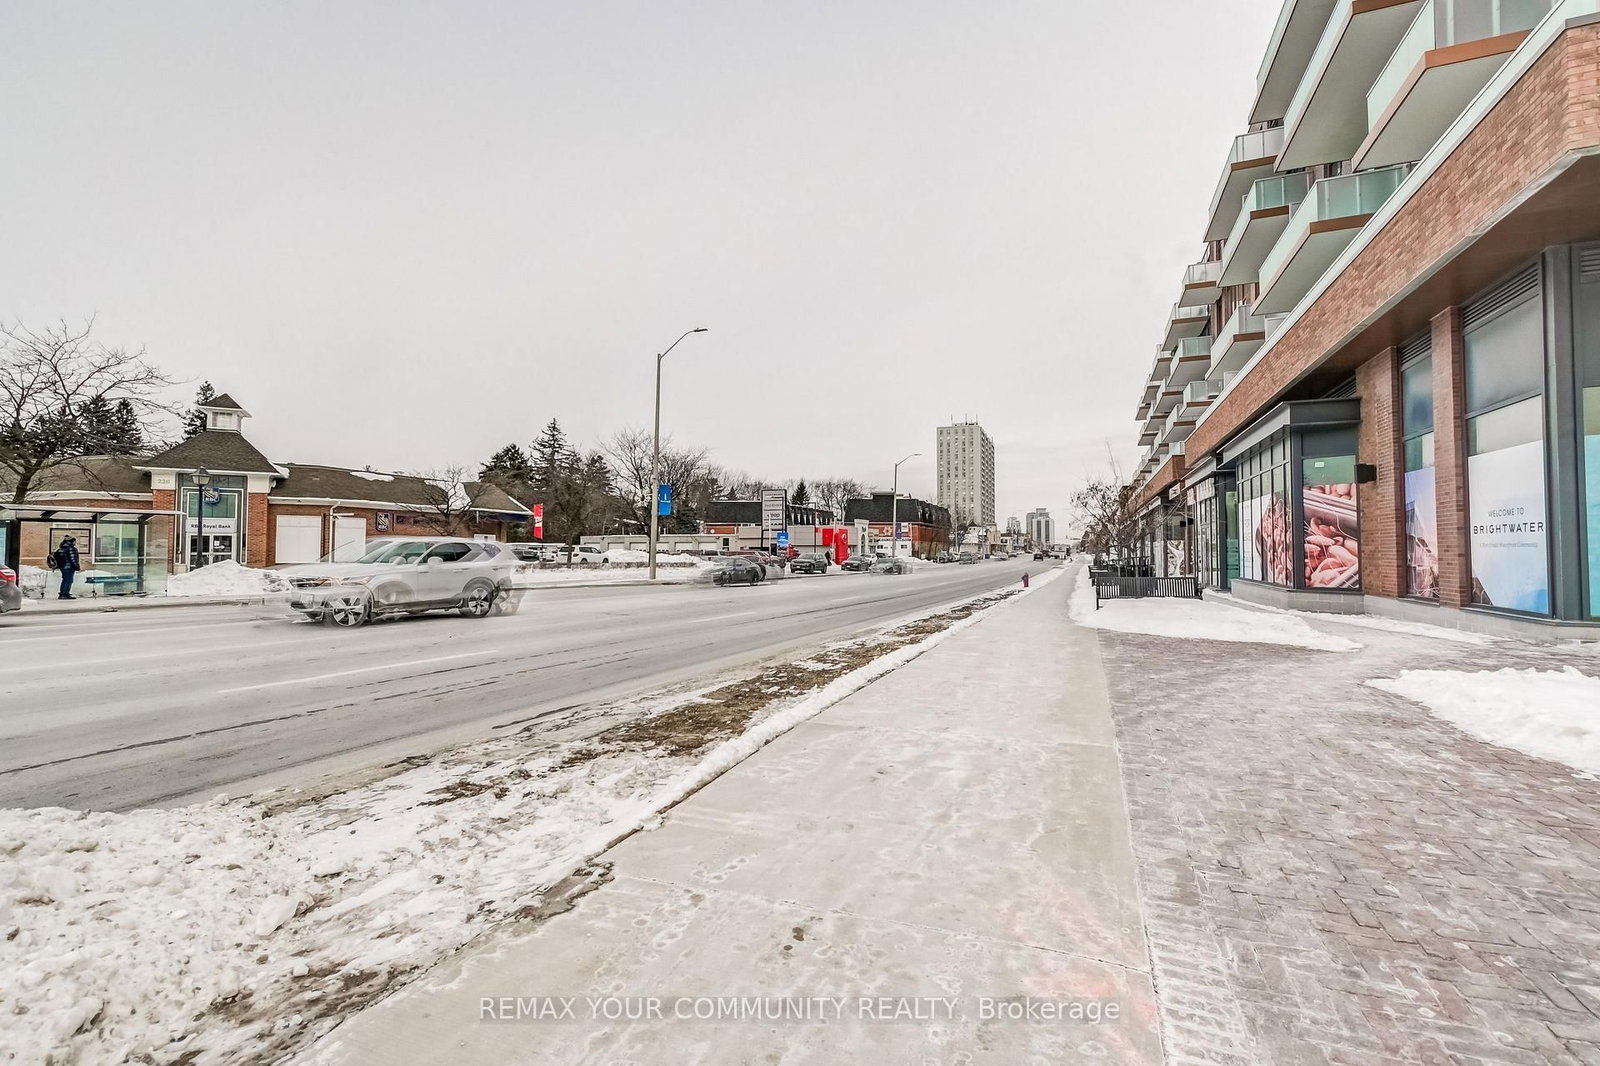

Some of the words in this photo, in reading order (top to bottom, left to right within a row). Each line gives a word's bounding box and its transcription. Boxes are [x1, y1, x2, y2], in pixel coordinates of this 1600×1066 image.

[1488, 508, 1515, 518] WELCOME
[1517, 507, 1524, 515] TO
[1473, 521, 1544, 535] BRIGHTWATER
